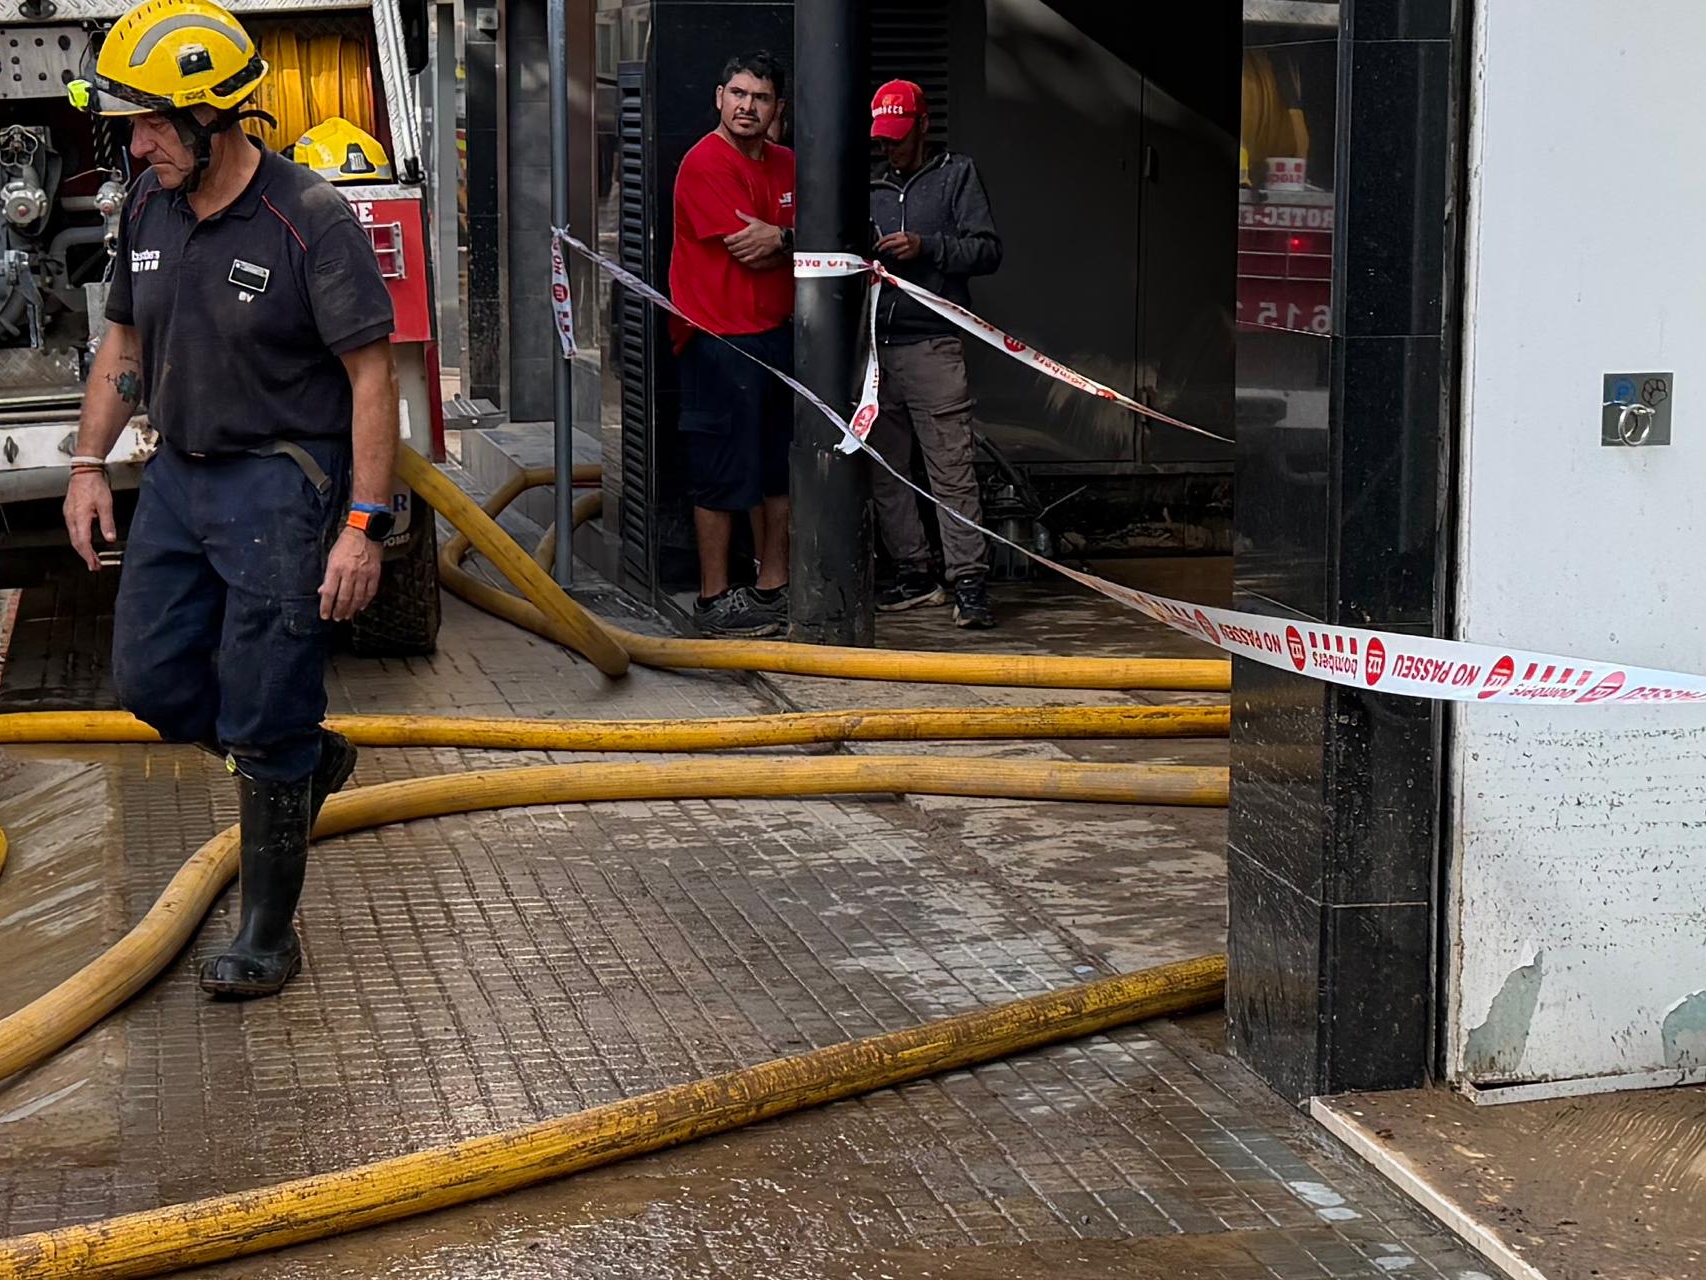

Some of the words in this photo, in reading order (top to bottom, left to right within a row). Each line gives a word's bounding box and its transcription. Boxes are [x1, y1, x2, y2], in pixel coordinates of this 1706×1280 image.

[1263, 631, 1283, 656] NO
[1312, 651, 1358, 679] bombers
[1391, 654, 1453, 684] PASSEU
[1453, 664, 1482, 688] NO
